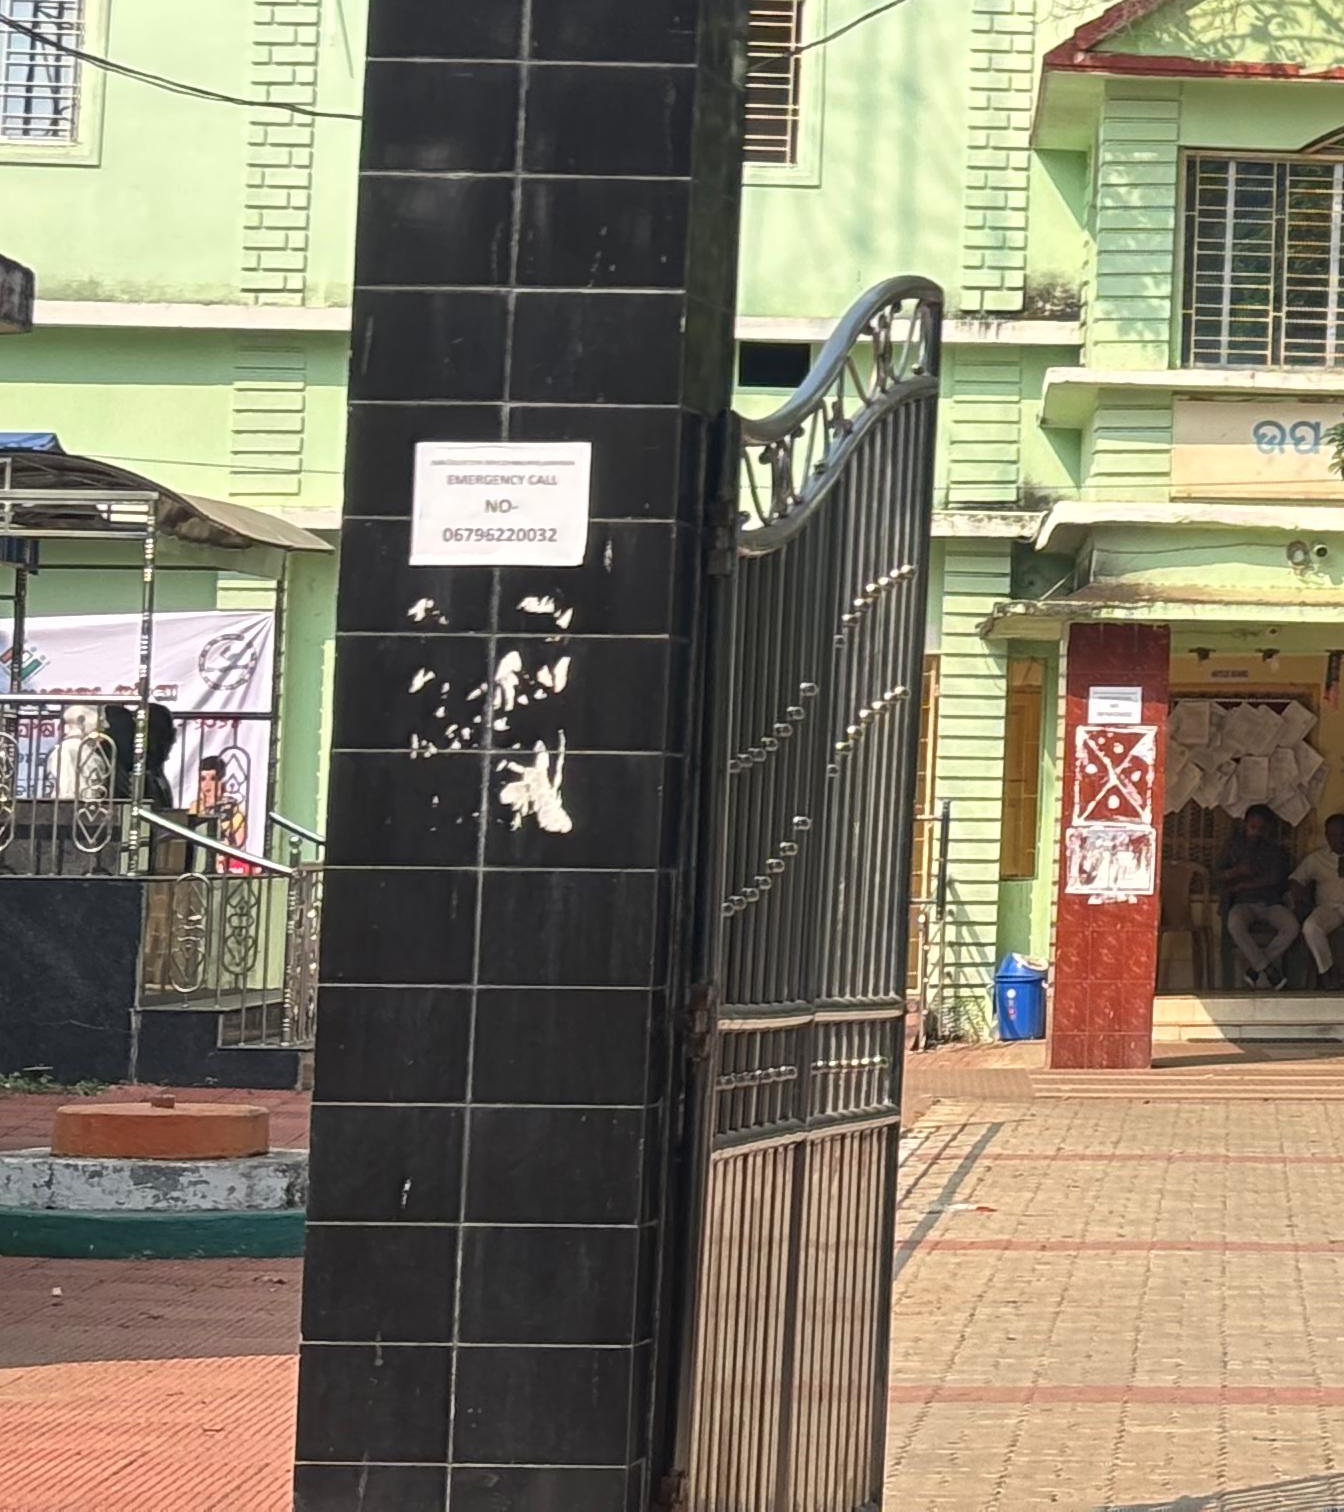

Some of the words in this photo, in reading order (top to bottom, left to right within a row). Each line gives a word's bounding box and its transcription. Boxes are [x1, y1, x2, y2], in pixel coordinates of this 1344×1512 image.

[447, 474, 524, 485] EMERGENCY
[528, 474, 558, 485] CALL
[442, 528, 558, 542] 06796220032
